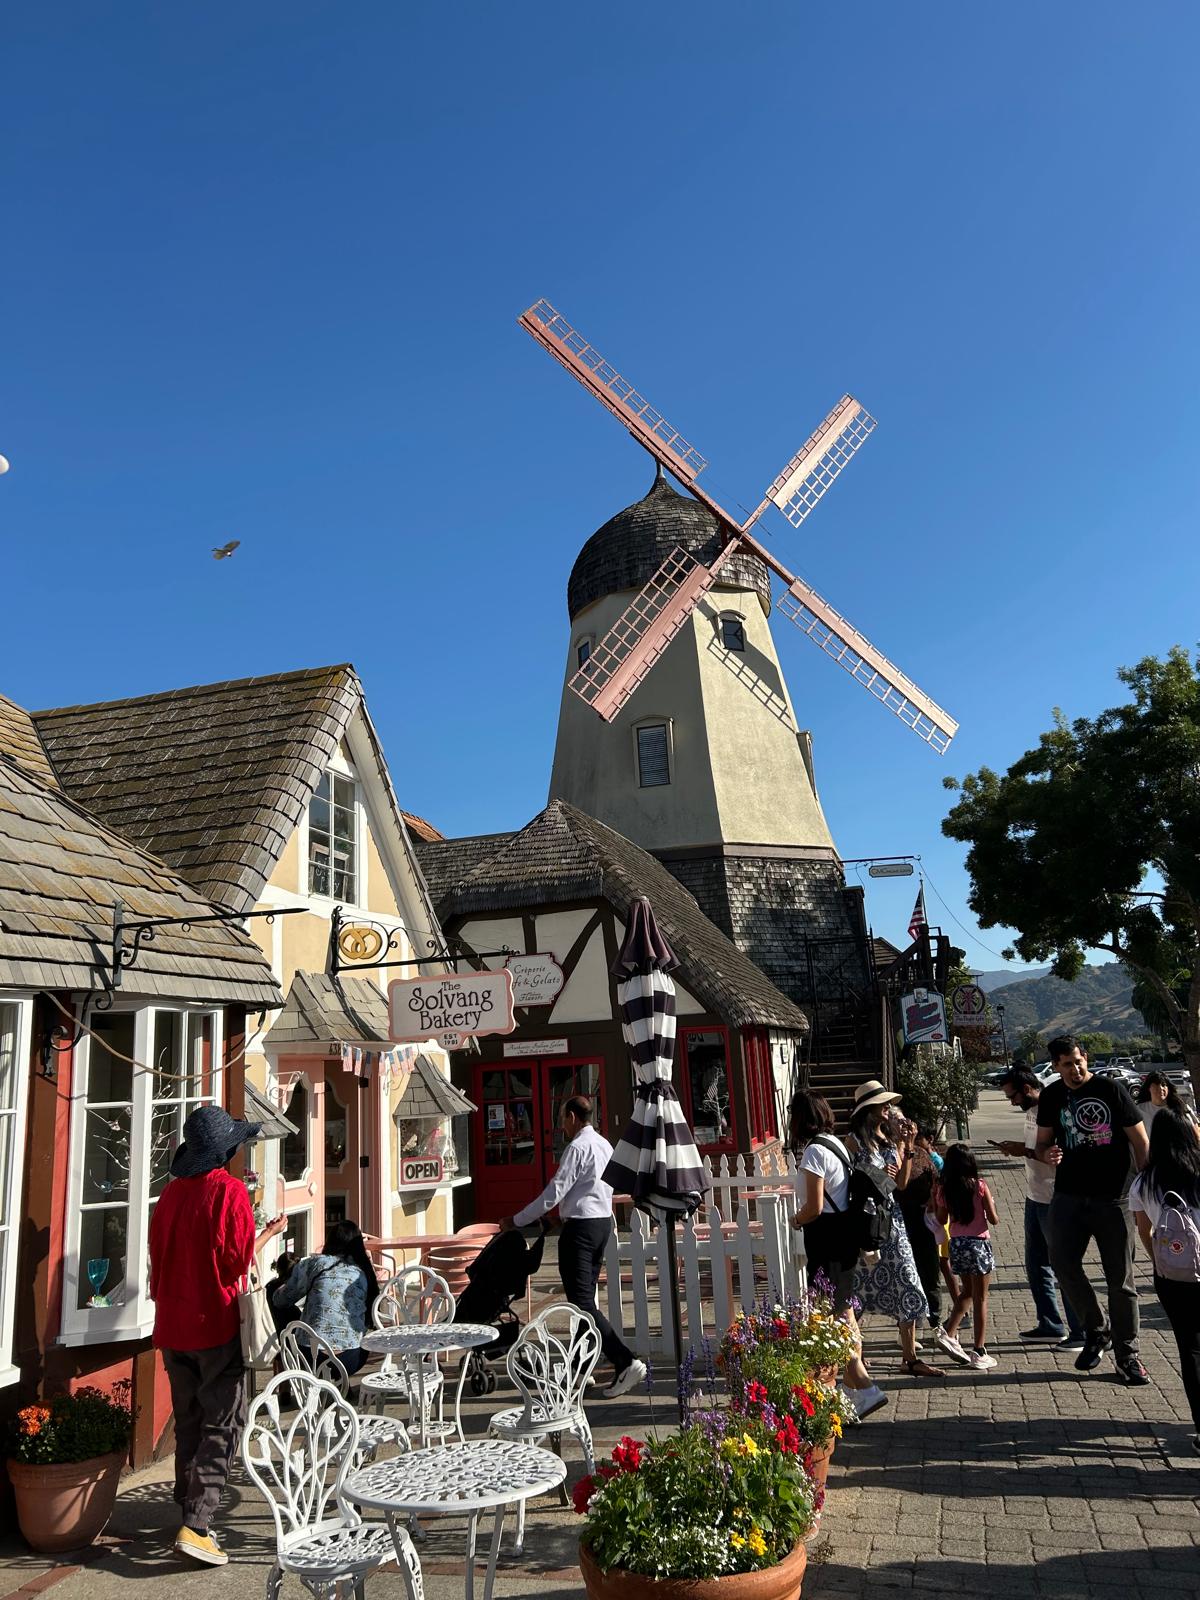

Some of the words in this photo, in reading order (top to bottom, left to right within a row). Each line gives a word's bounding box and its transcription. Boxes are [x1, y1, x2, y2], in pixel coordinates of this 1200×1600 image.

[441, 981, 461, 991] The
[530, 972, 560, 988] Gelato
[408, 987, 493, 1012] Solvang
[419, 1009, 482, 1031] Bakery
[405, 1162, 439, 1180] OPEN
